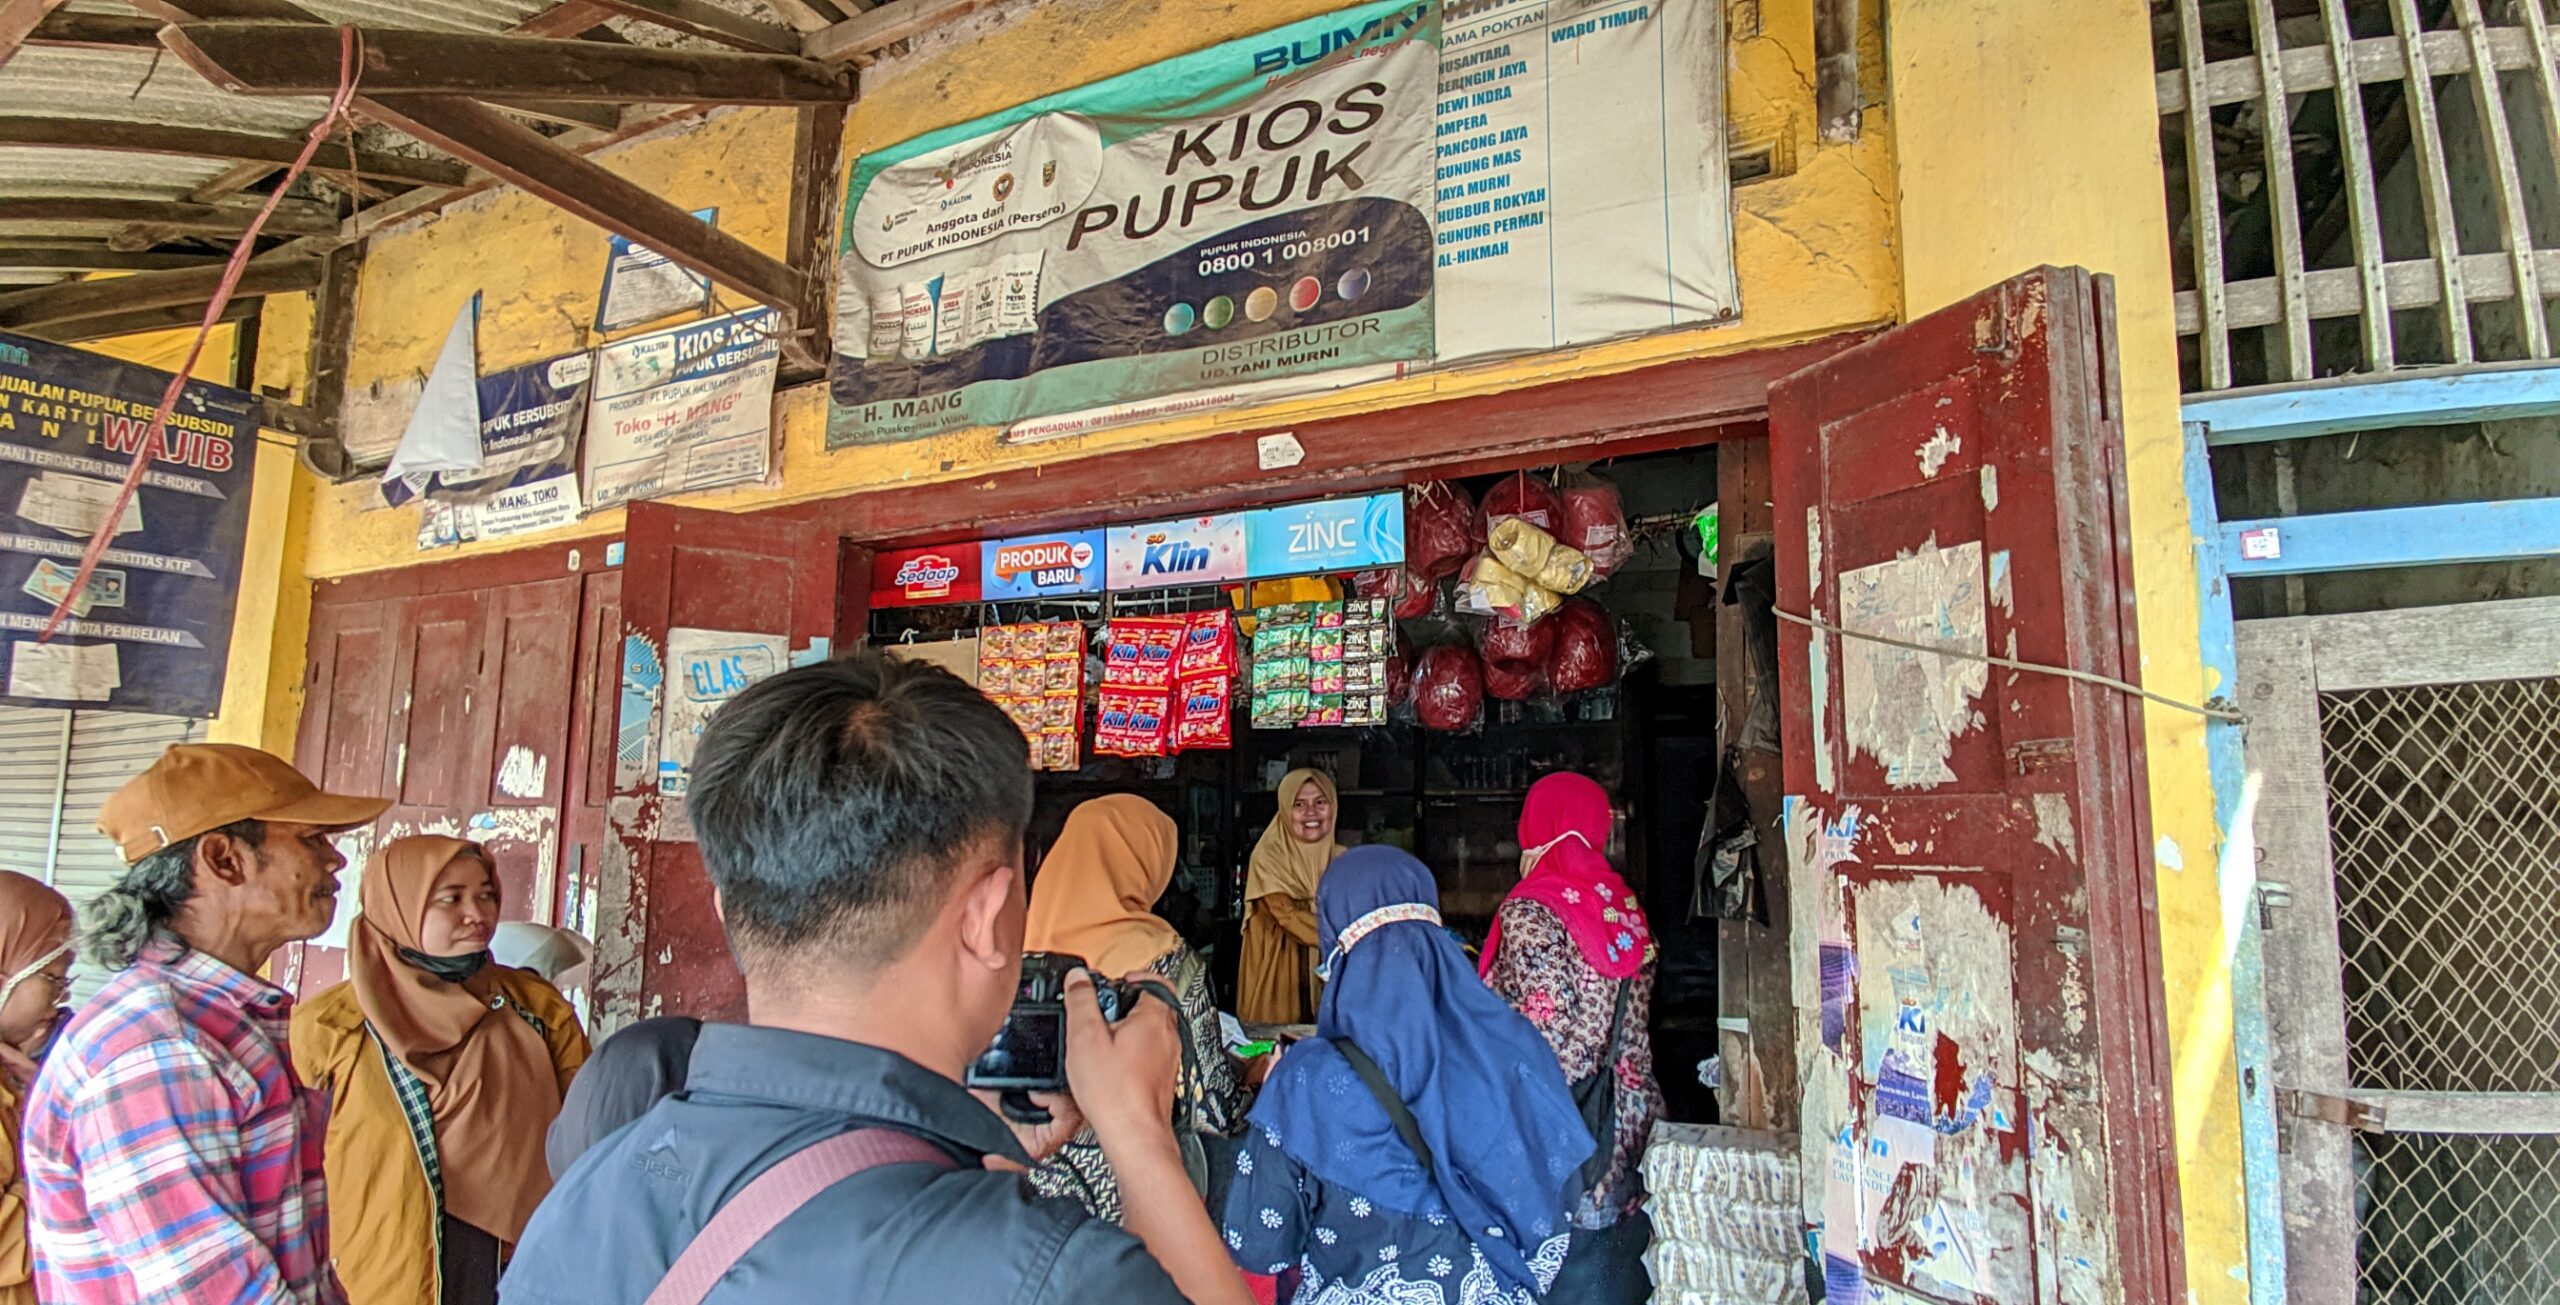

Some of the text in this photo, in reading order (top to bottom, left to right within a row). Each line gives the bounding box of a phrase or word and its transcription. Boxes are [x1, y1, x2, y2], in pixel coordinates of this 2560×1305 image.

[1440, 30, 1477, 49] AMA
[1481, 10, 1545, 37] POKTAN
[1551, 6, 1649, 43] WARU TIMUR
[1253, 5, 1428, 76] BUMN
[1438, 44, 1511, 75] NUSANTARA
[1437, 61, 1527, 95] BERINGIN JAYA
[1436, 85, 1512, 116] DEWI INDRA
[1165, 81, 1387, 176] KIOS
[1436, 113, 1488, 138] AMPERA
[1436, 125, 1528, 159] PANCONG JAYA
[1437, 149, 1521, 181] GUNUNG MAS
[1066, 141, 1371, 251] PUPUK
[1437, 173, 1511, 204] JAYA MURNI
[926, 213, 978, 235] Anggota
[982, 202, 1005, 219] dari
[1437, 188, 1546, 225] HUBBUR ROKYAH
[880, 201, 1066, 264] PT PUPUK INDONESIA (Persero)
[1200, 230, 1307, 258] PUPUK INDONESIA
[1438, 211, 1544, 246] GUNUNG PERMAI
[1198, 226, 1370, 277] 0800 1 008001
[1438, 241, 1509, 268] AL-HIKMAH
[679, 327, 725, 361] KIOS
[1202, 317, 1381, 365] DISTRIBUTOR
[1277, 346, 1340, 367] MURNI
[68, 389, 128, 418] PUPUK
[662, 387, 691, 401] PUPUK
[864, 391, 963, 423] H. MANG
[21, 399, 98, 427] KARTU
[614, 418, 651, 437] Toko
[877, 420, 938, 436] Puskesmas
[940, 413, 969, 426] Waru
[1027, 420, 1083, 436] PENGADUAN
[103, 413, 234, 473] WAJIB
[490, 430, 532, 450] Indonesia
[29, 449, 103, 474] TERDAFTAR
[105, 463, 151, 484] DAL
[153, 471, 204, 493] E-RDKK
[532, 485, 558, 503] TOKO
[105, 549, 163, 569] DENTITAS
[166, 558, 192, 572] KTP
[1000, 545, 1069, 569] PRODUK
[1141, 540, 1212, 577] Klin
[896, 567, 958, 585] Sedaap
[1037, 567, 1076, 587] BARU
[10, 614, 67, 632] MENGSI
[70, 619, 102, 636] NOTA
[103, 623, 180, 644] PEMBELIAN
[1189, 626, 1219, 643] Klin
[1141, 644, 1173, 661] Klin
[1186, 695, 1220, 713] Klin
[1129, 712, 1160, 730] Klin
[1839, 1124, 1889, 1158] Kn
[1833, 1157, 1893, 1183] PROENCE
